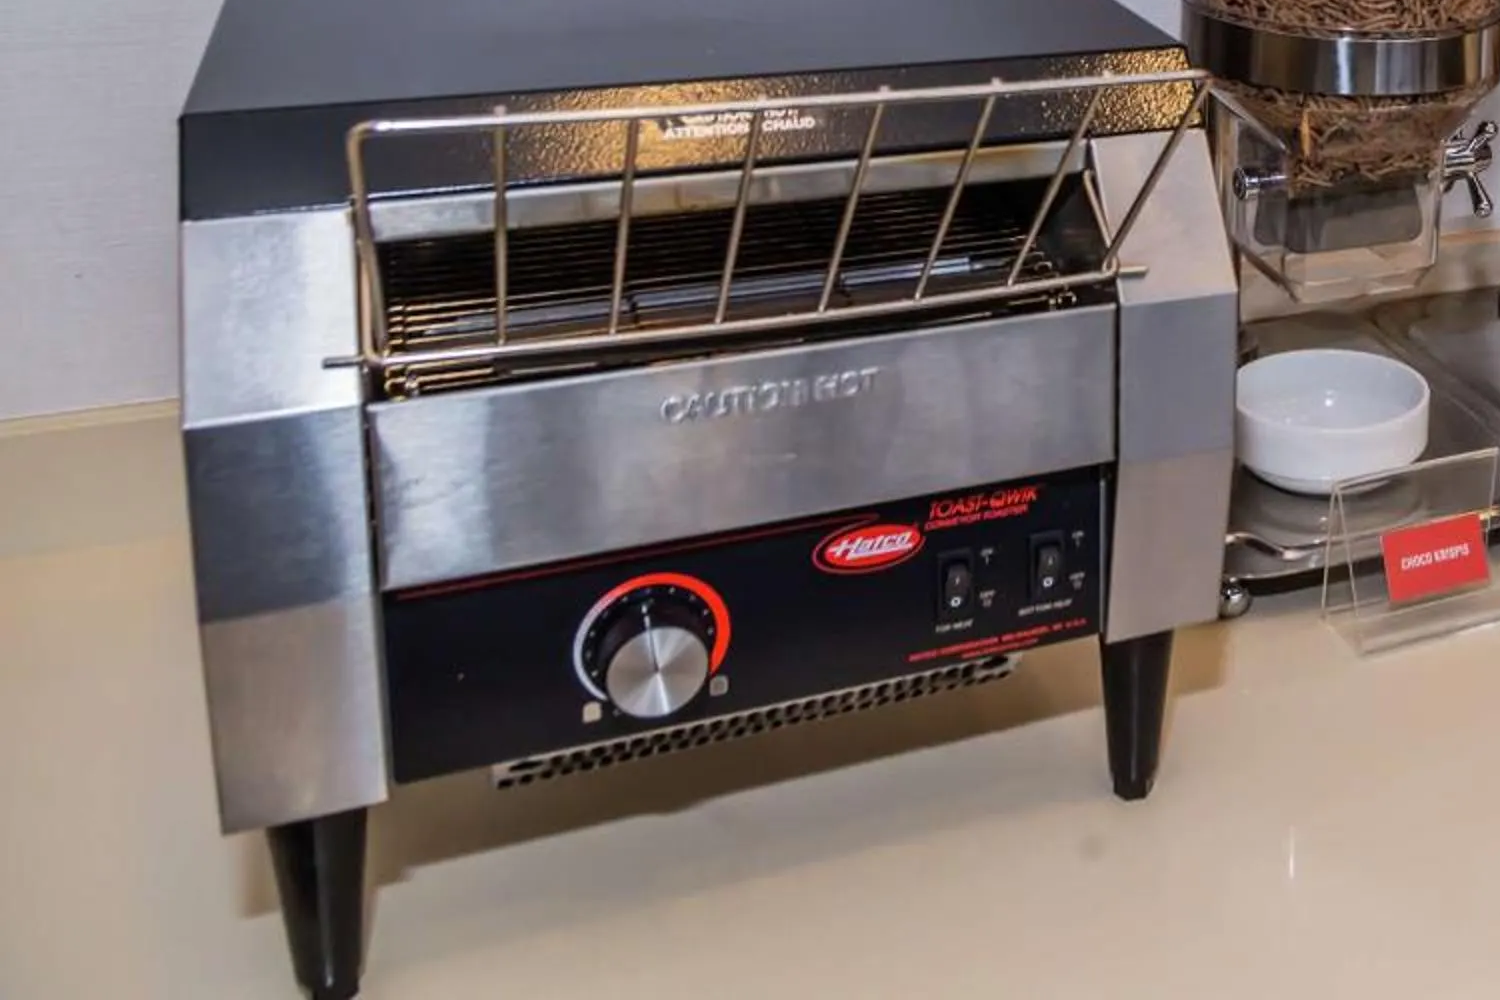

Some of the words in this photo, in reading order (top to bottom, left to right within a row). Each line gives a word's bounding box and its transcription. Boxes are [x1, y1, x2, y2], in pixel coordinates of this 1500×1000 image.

[663, 119, 750, 140] ATTENTION
[761, 115, 816, 132] CHAUD
[812, 366, 880, 402] HOT
[833, 531, 914, 561] Hatco
[1401, 552, 1433, 571] CHOCO
